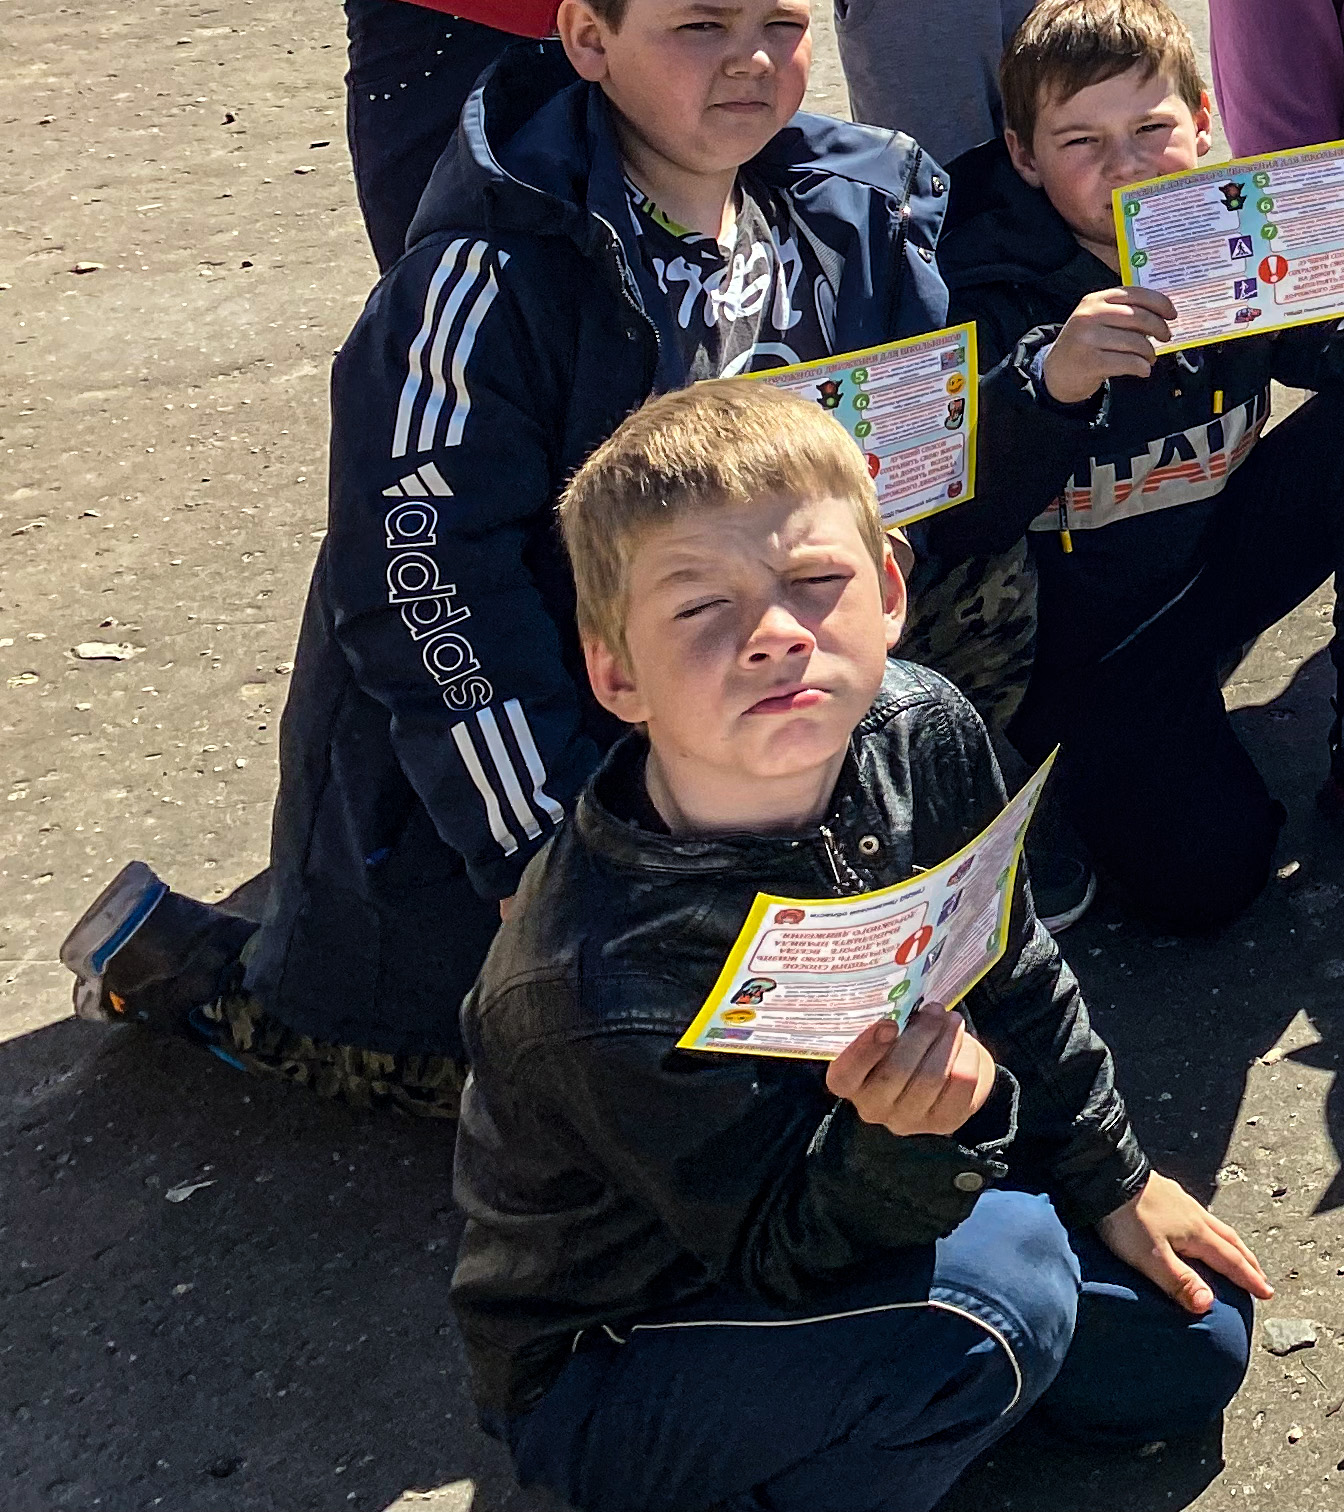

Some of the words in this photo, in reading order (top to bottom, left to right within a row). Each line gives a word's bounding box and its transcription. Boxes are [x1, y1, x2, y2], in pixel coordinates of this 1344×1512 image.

[1257, 174, 1266, 186] 5
[1128, 204, 1135, 215] 1
[1261, 201, 1270, 211] 6
[1264, 227, 1274, 237] 7
[1134, 255, 1145, 265] 2
[855, 371, 864, 382] 5
[857, 397, 866, 407] 6
[858, 424, 868, 434] 7
